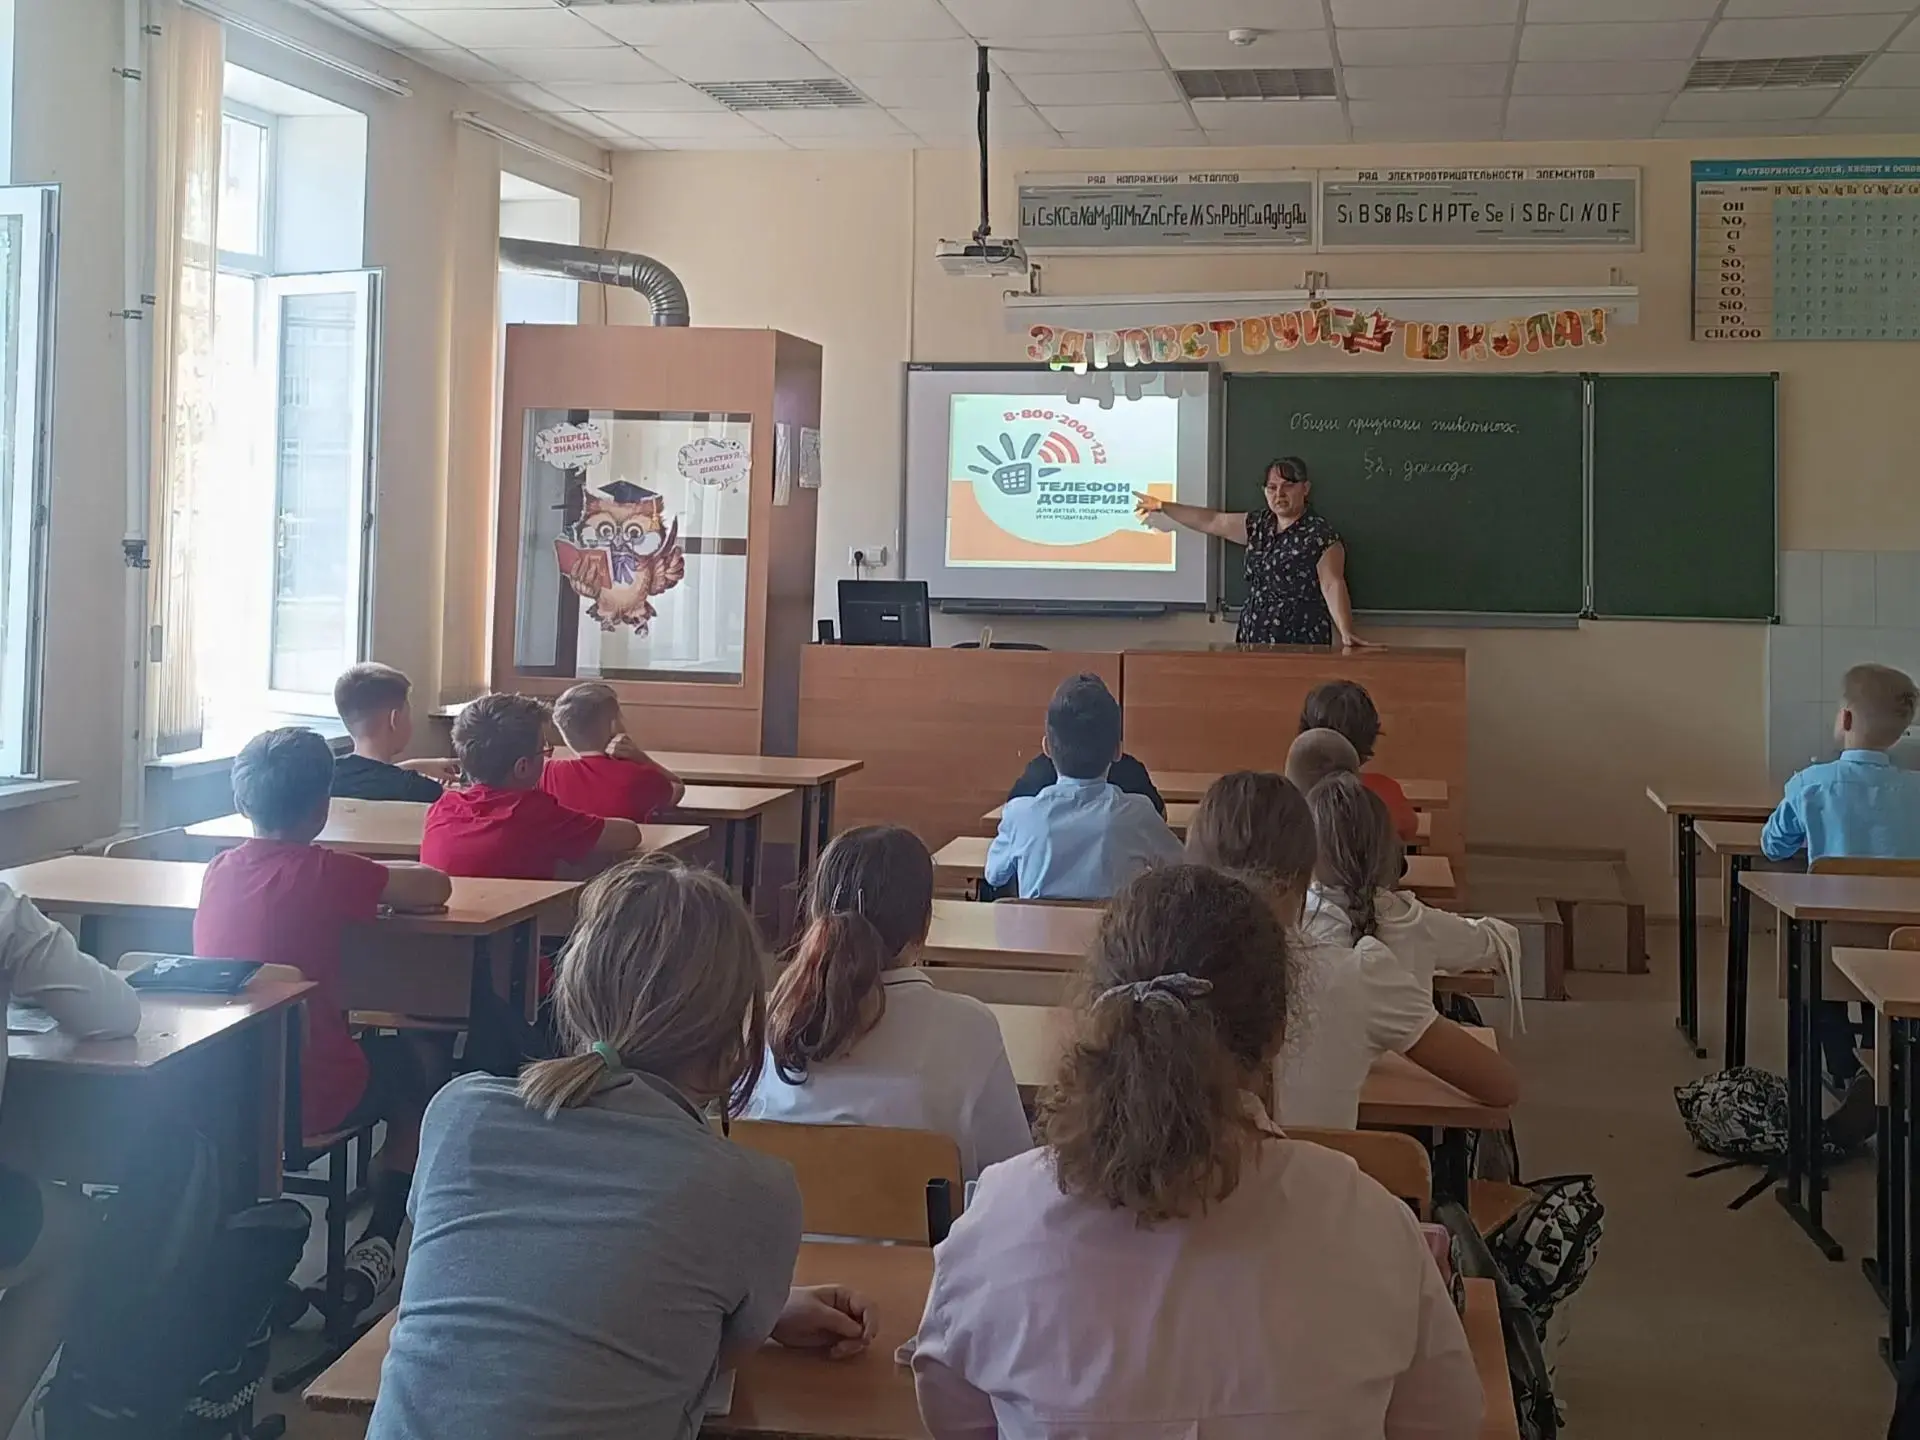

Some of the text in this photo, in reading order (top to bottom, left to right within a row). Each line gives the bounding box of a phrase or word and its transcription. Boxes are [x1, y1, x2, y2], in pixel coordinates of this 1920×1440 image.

[1087, 175, 1106, 185] РЯД
[1188, 173, 1240, 183] МЕТАЛЛОВ
[1358, 169, 1595, 181] РЯД ЭЛЕКТРООТРИЦАТЕЛЬНОСТИ ЭЛЕМЕНТОВ
[1359, 203, 1370, 223] B
[1396, 203, 1414, 223] As
[1418, 203, 1428, 223] C
[1433, 203, 1443, 223] H
[1485, 203, 1504, 223] Se
[1522, 203, 1533, 223] S
[1537, 203, 1555, 223] Br
[1581, 203, 1595, 223] N
[1612, 203, 1623, 223] F
[1727, 244, 1736, 254] S
[1403, 307, 1608, 363] ШКОЛА!
[1347, 415, 1421, 436] признаки
[1037, 482, 1130, 492] ТЕЛЕФОН
[1036, 494, 1129, 505] ДОВЕРИЯ
